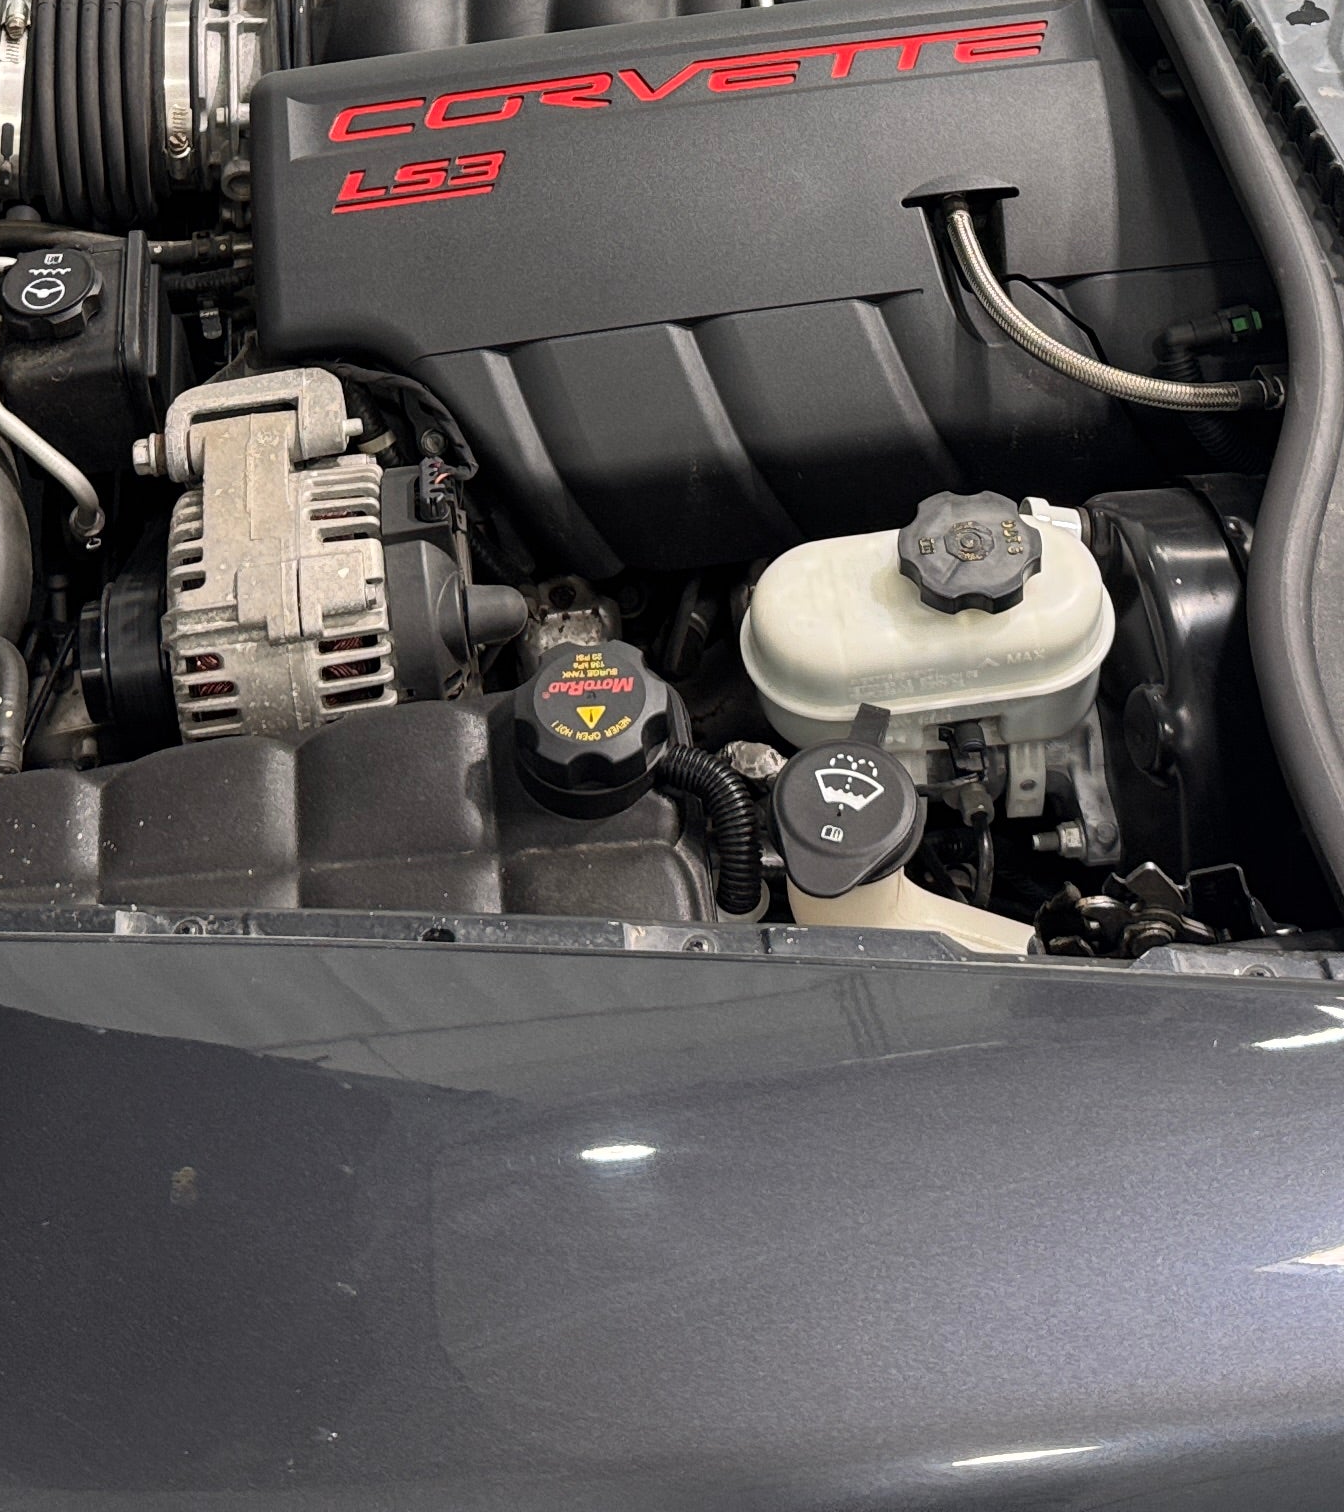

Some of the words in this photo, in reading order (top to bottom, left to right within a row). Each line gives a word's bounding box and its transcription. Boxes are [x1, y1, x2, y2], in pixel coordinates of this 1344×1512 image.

[328, 19, 1048, 144] CORVETTE
[336, 149, 507, 205] LS3
[1007, 648, 1045, 664] MAX
[561, 670, 586, 679] TANK
[586, 668, 619, 677] SURGE
[603, 716, 632, 737] NEVER
[576, 731, 601, 741] OPEN
